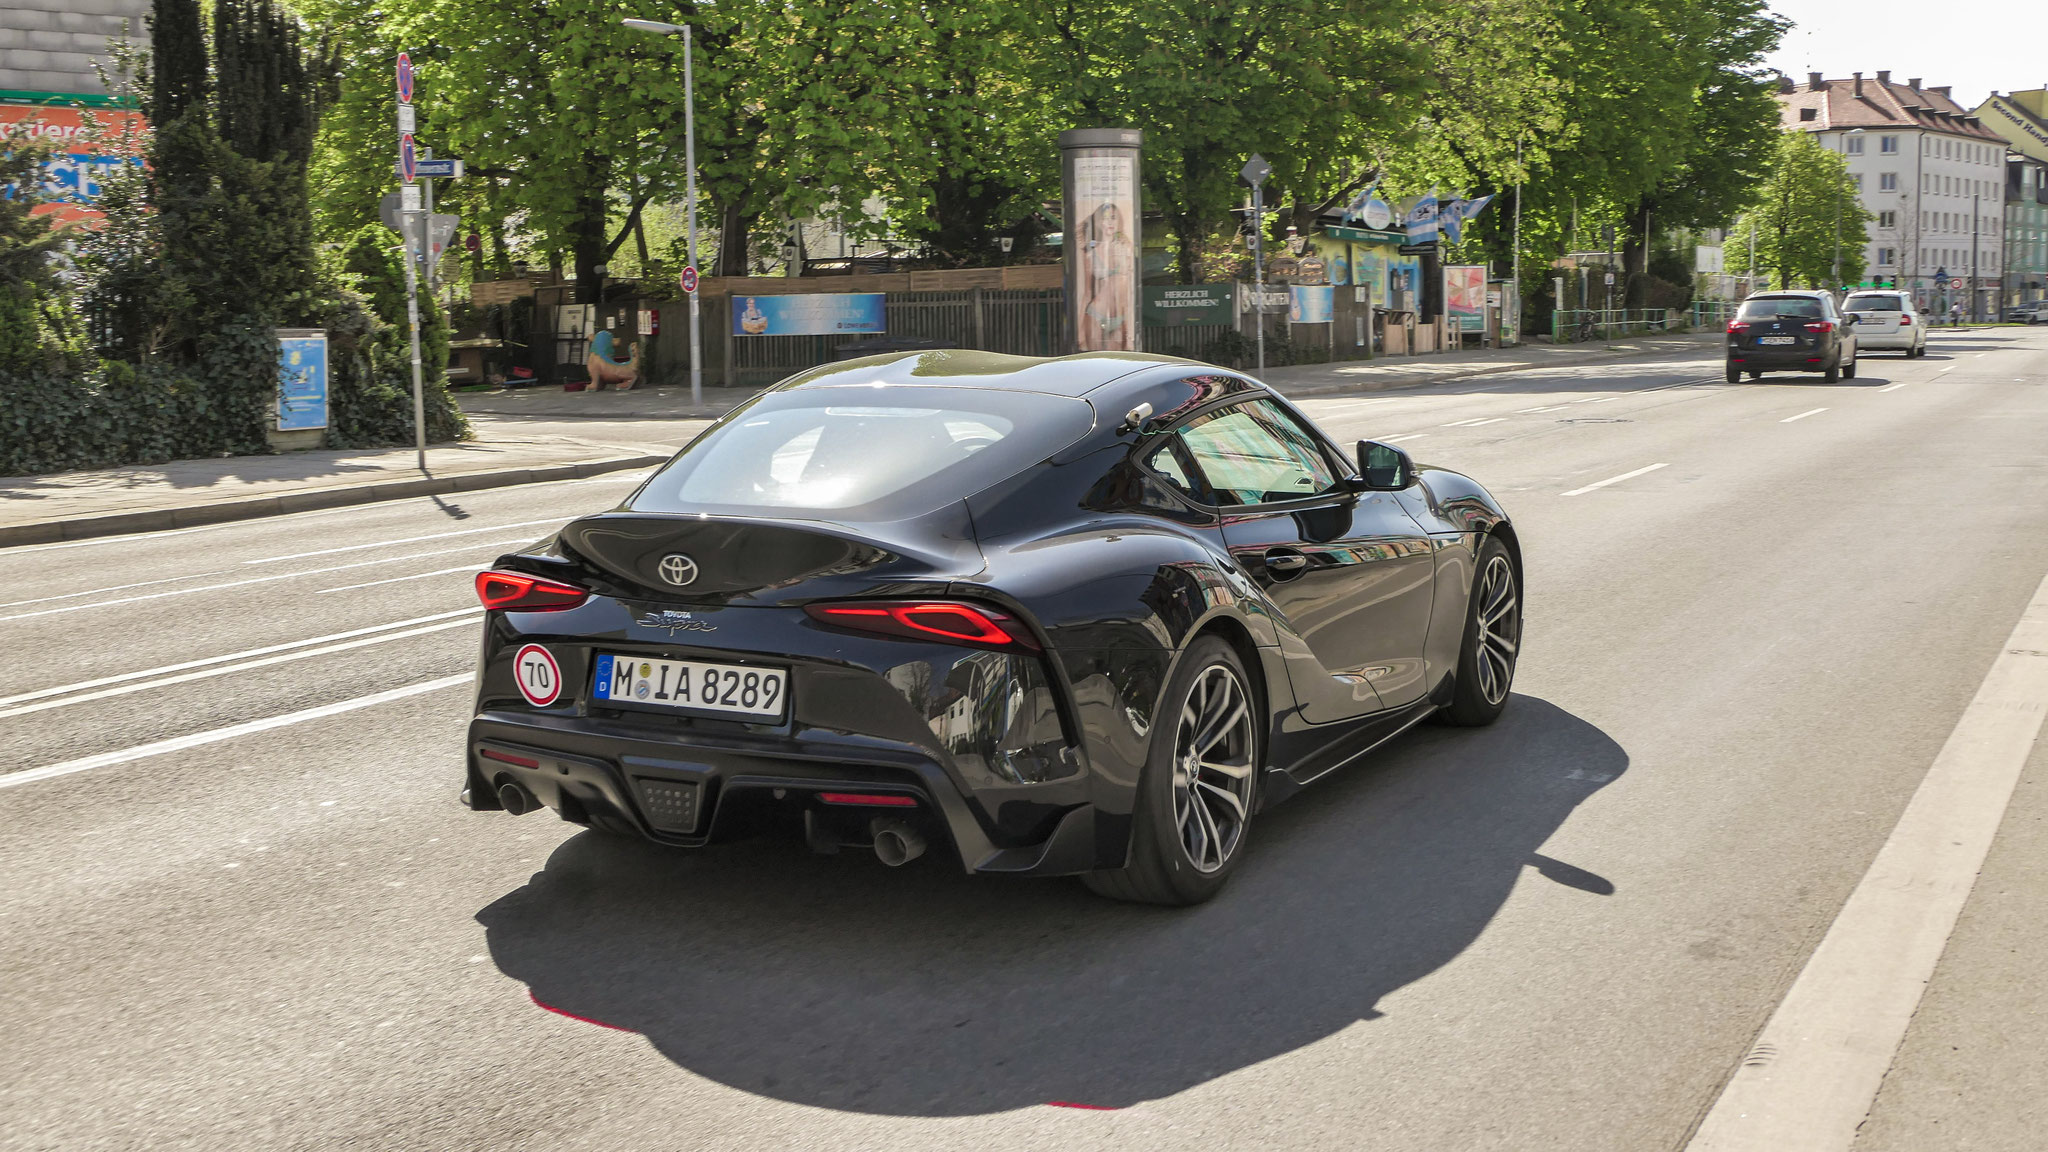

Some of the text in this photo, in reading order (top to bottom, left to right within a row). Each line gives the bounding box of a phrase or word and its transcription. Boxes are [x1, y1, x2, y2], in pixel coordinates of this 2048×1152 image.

[1991, 100, 2048, 147] Second Hand
[1154, 298, 1219, 308] WILLKOMMEN!
[1164, 290, 1208, 299] HERZLICH
[662, 610, 692, 619] TOYOTA
[636, 612, 718, 637] Supra
[524, 661, 549, 689] 70
[599, 681, 607, 692] D
[614, 660, 781, 710] M IA 8289
